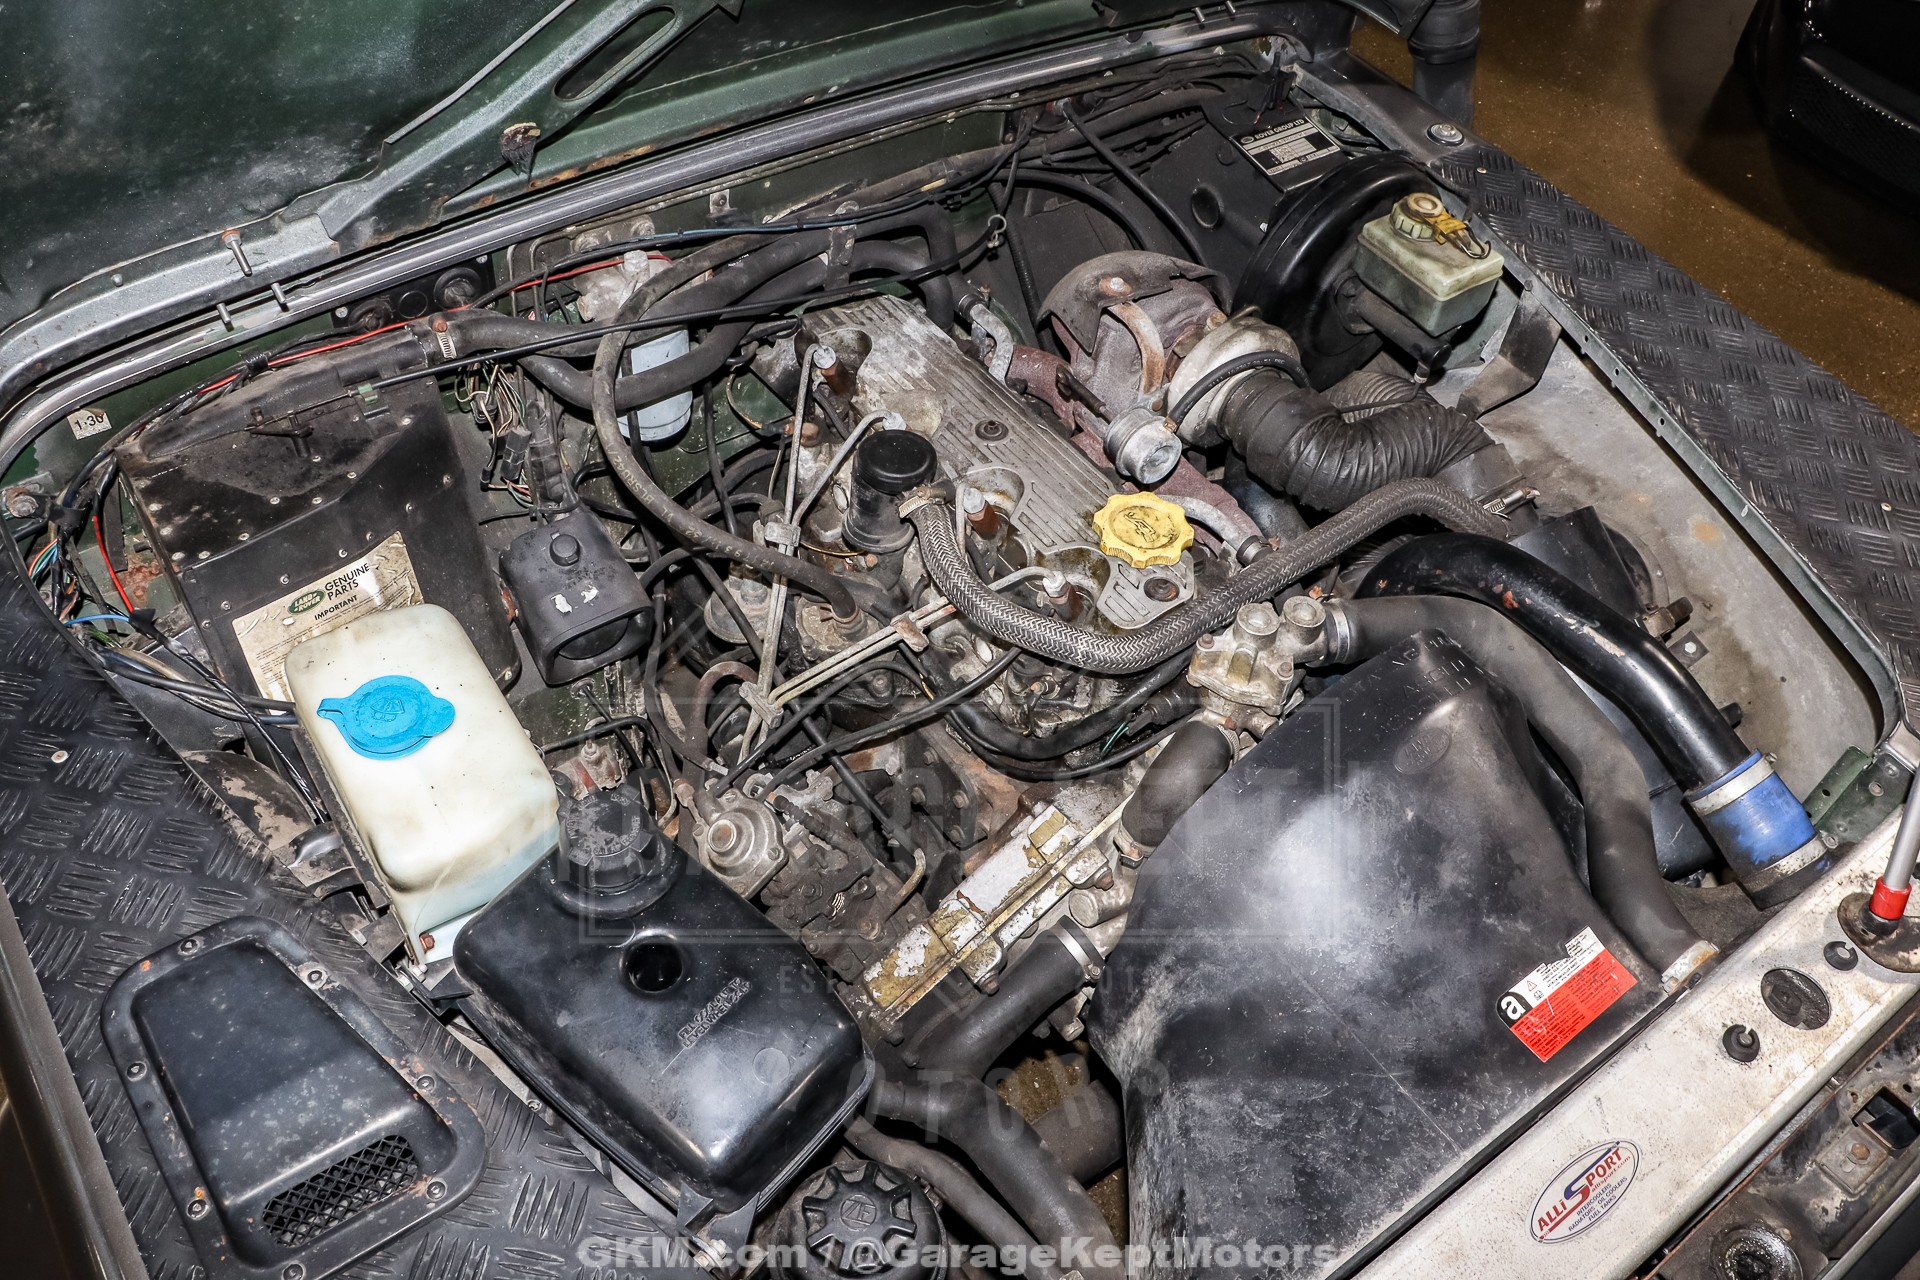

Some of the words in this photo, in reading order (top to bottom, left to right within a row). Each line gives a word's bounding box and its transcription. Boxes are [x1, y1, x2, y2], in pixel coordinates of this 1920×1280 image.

[1274, 122, 1293, 133] GROUP
[1293, 118, 1305, 127] LTD
[324, 563, 370, 592] GENUINE
[327, 579, 359, 601] PARTS
[294, 593, 314, 608] LAND
[298, 594, 322, 613] ROVER
[314, 594, 358, 621] IMPORTANT
[705, 1001, 732, 1024] WHEN
[1500, 995, 1527, 1021] a
[1568, 1206, 1596, 1232] RADIATORS
[1605, 1176, 1628, 1198] COOLERS
[1576, 1183, 1612, 1216] INTERCOOLERS
[1588, 1209, 1602, 1222] FUEL
[1600, 1194, 1617, 1210] TANKS
